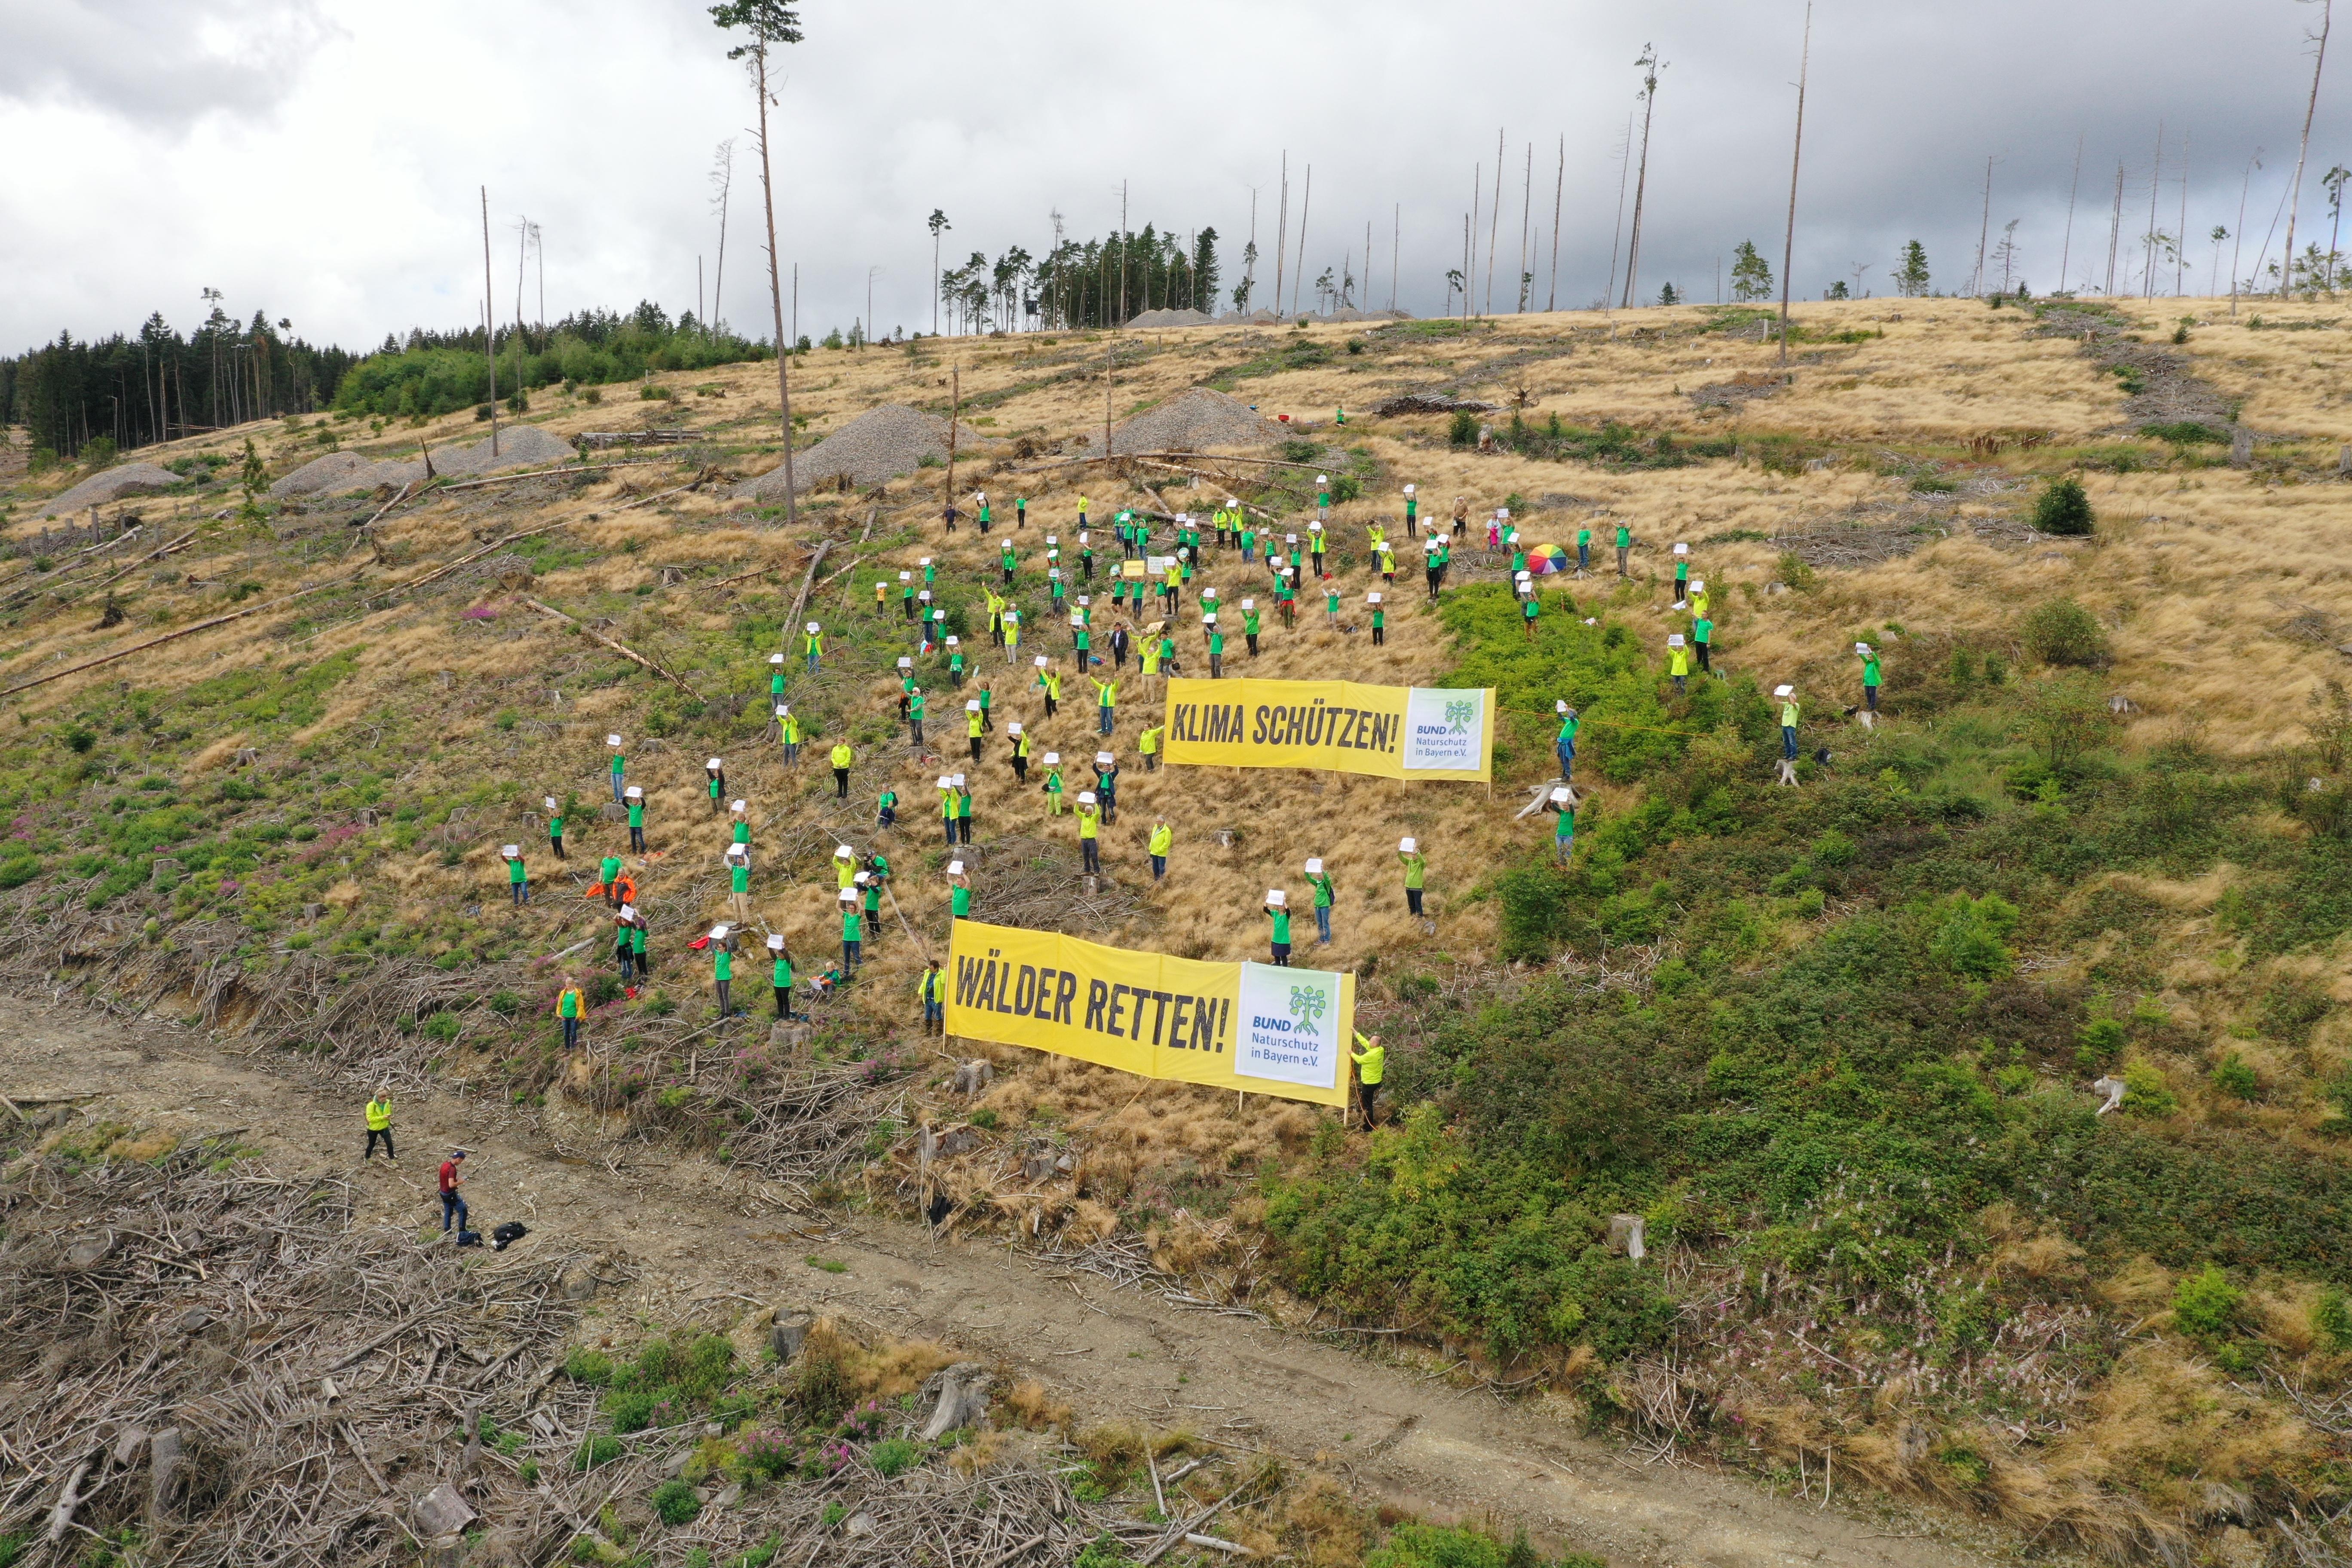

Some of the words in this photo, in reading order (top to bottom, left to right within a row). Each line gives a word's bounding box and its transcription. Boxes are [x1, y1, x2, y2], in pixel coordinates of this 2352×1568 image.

[1171, 704, 1243, 743] KLIMA
[1253, 698, 1400, 753] SCHÜTZEN!
[1417, 726, 1446, 735] BUND
[1416, 737, 1467, 746] Naturschutz
[1416, 747, 1423, 756] in
[1425, 748, 1452, 758] Bayern
[956, 948, 1076, 1025] WÄLDER
[1085, 979, 1230, 1053] RETTEN!
[1253, 1016, 1291, 1032] BUND
[1252, 1032, 1319, 1052] Naturschutz
[1251, 1047, 1260, 1058] in
[1263, 1049, 1299, 1064] Bayern
[1302, 1055, 1318, 1067] e.V.
